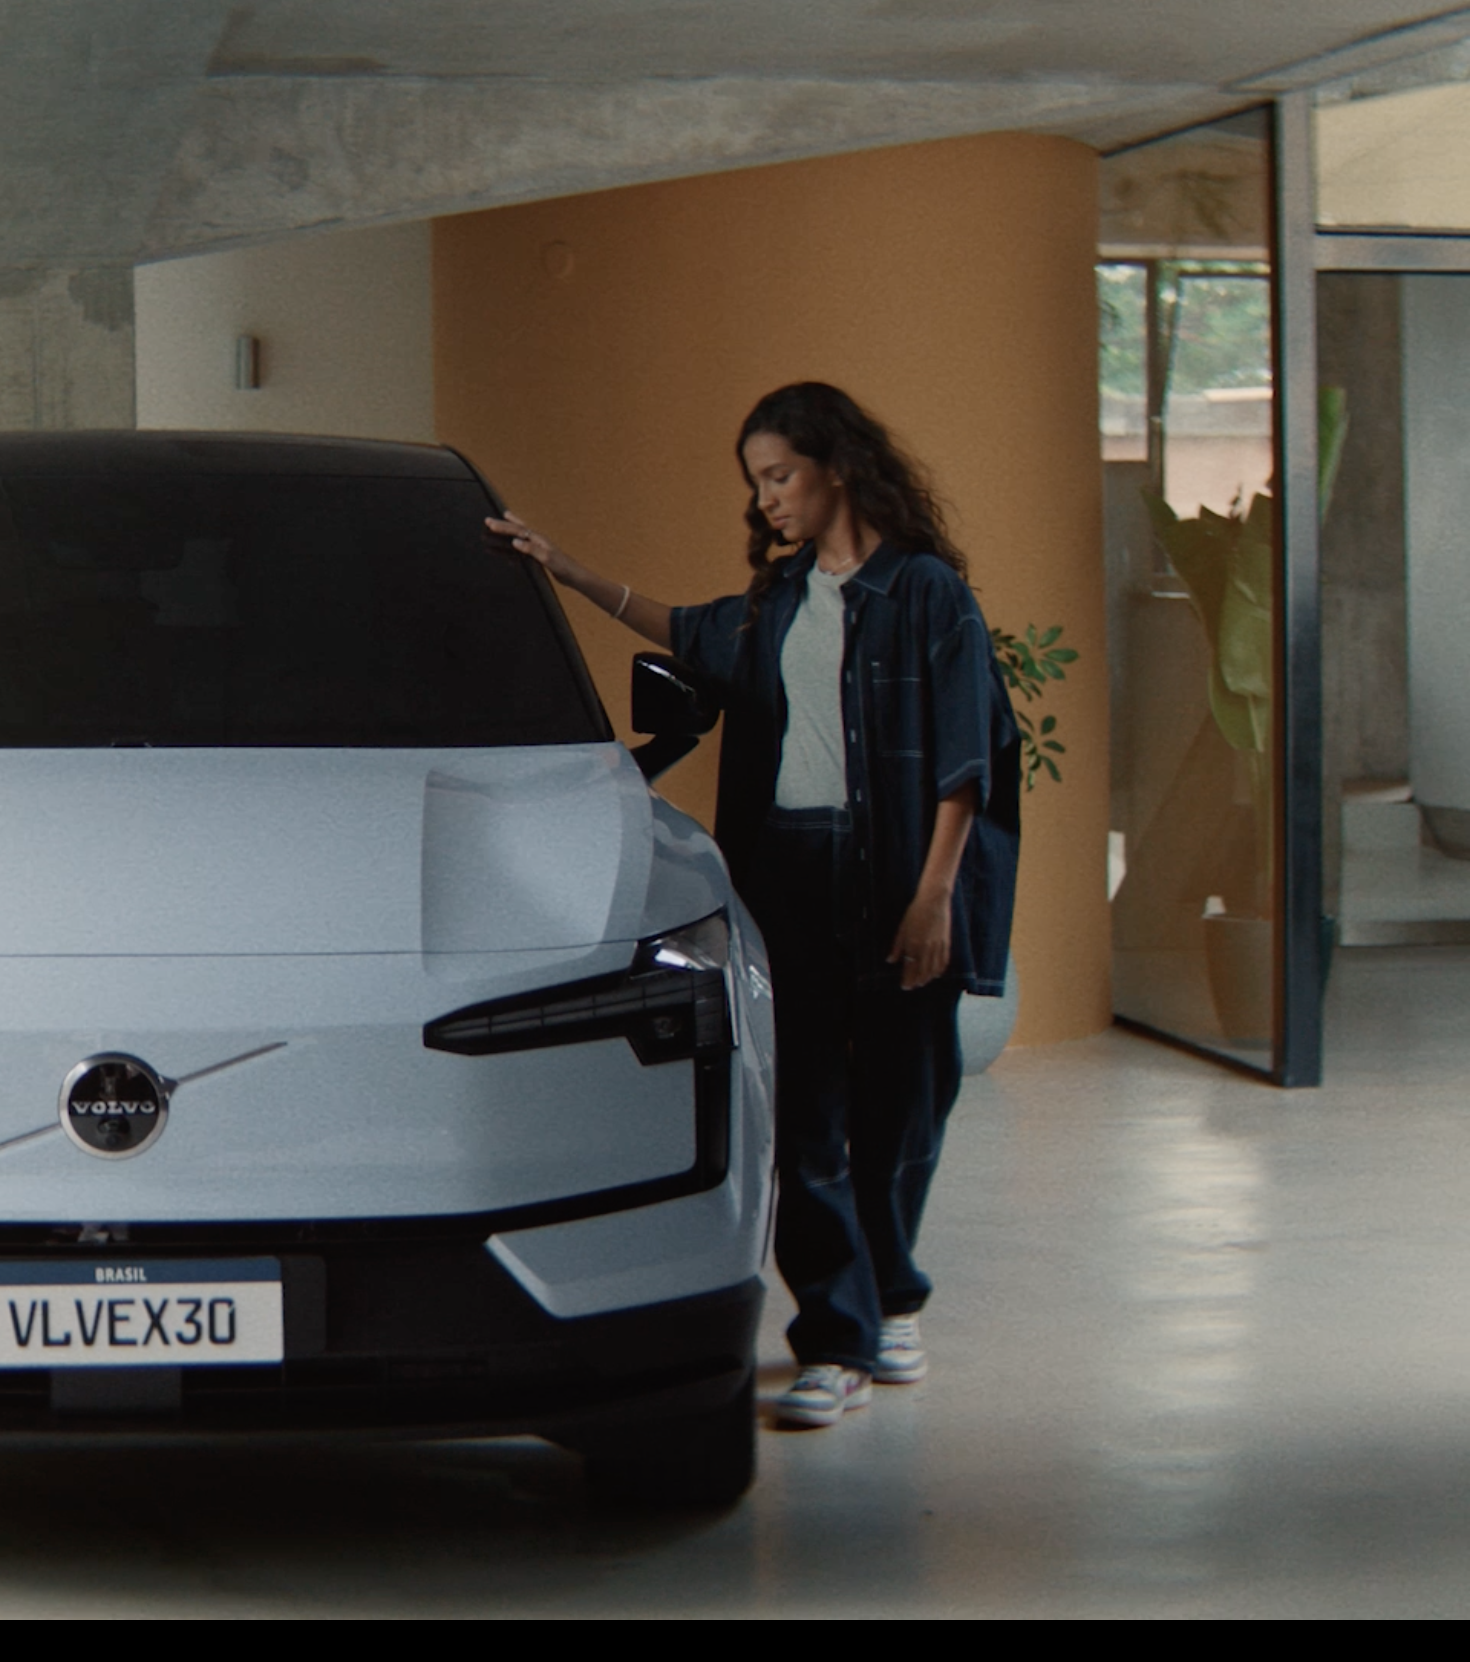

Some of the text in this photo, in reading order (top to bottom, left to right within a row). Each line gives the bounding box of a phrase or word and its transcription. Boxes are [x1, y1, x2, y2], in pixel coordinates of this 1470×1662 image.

[71, 1101, 156, 1115] VOLVO
[95, 1266, 147, 1282] BRASIL
[9, 1297, 236, 1347] VLVEX30
